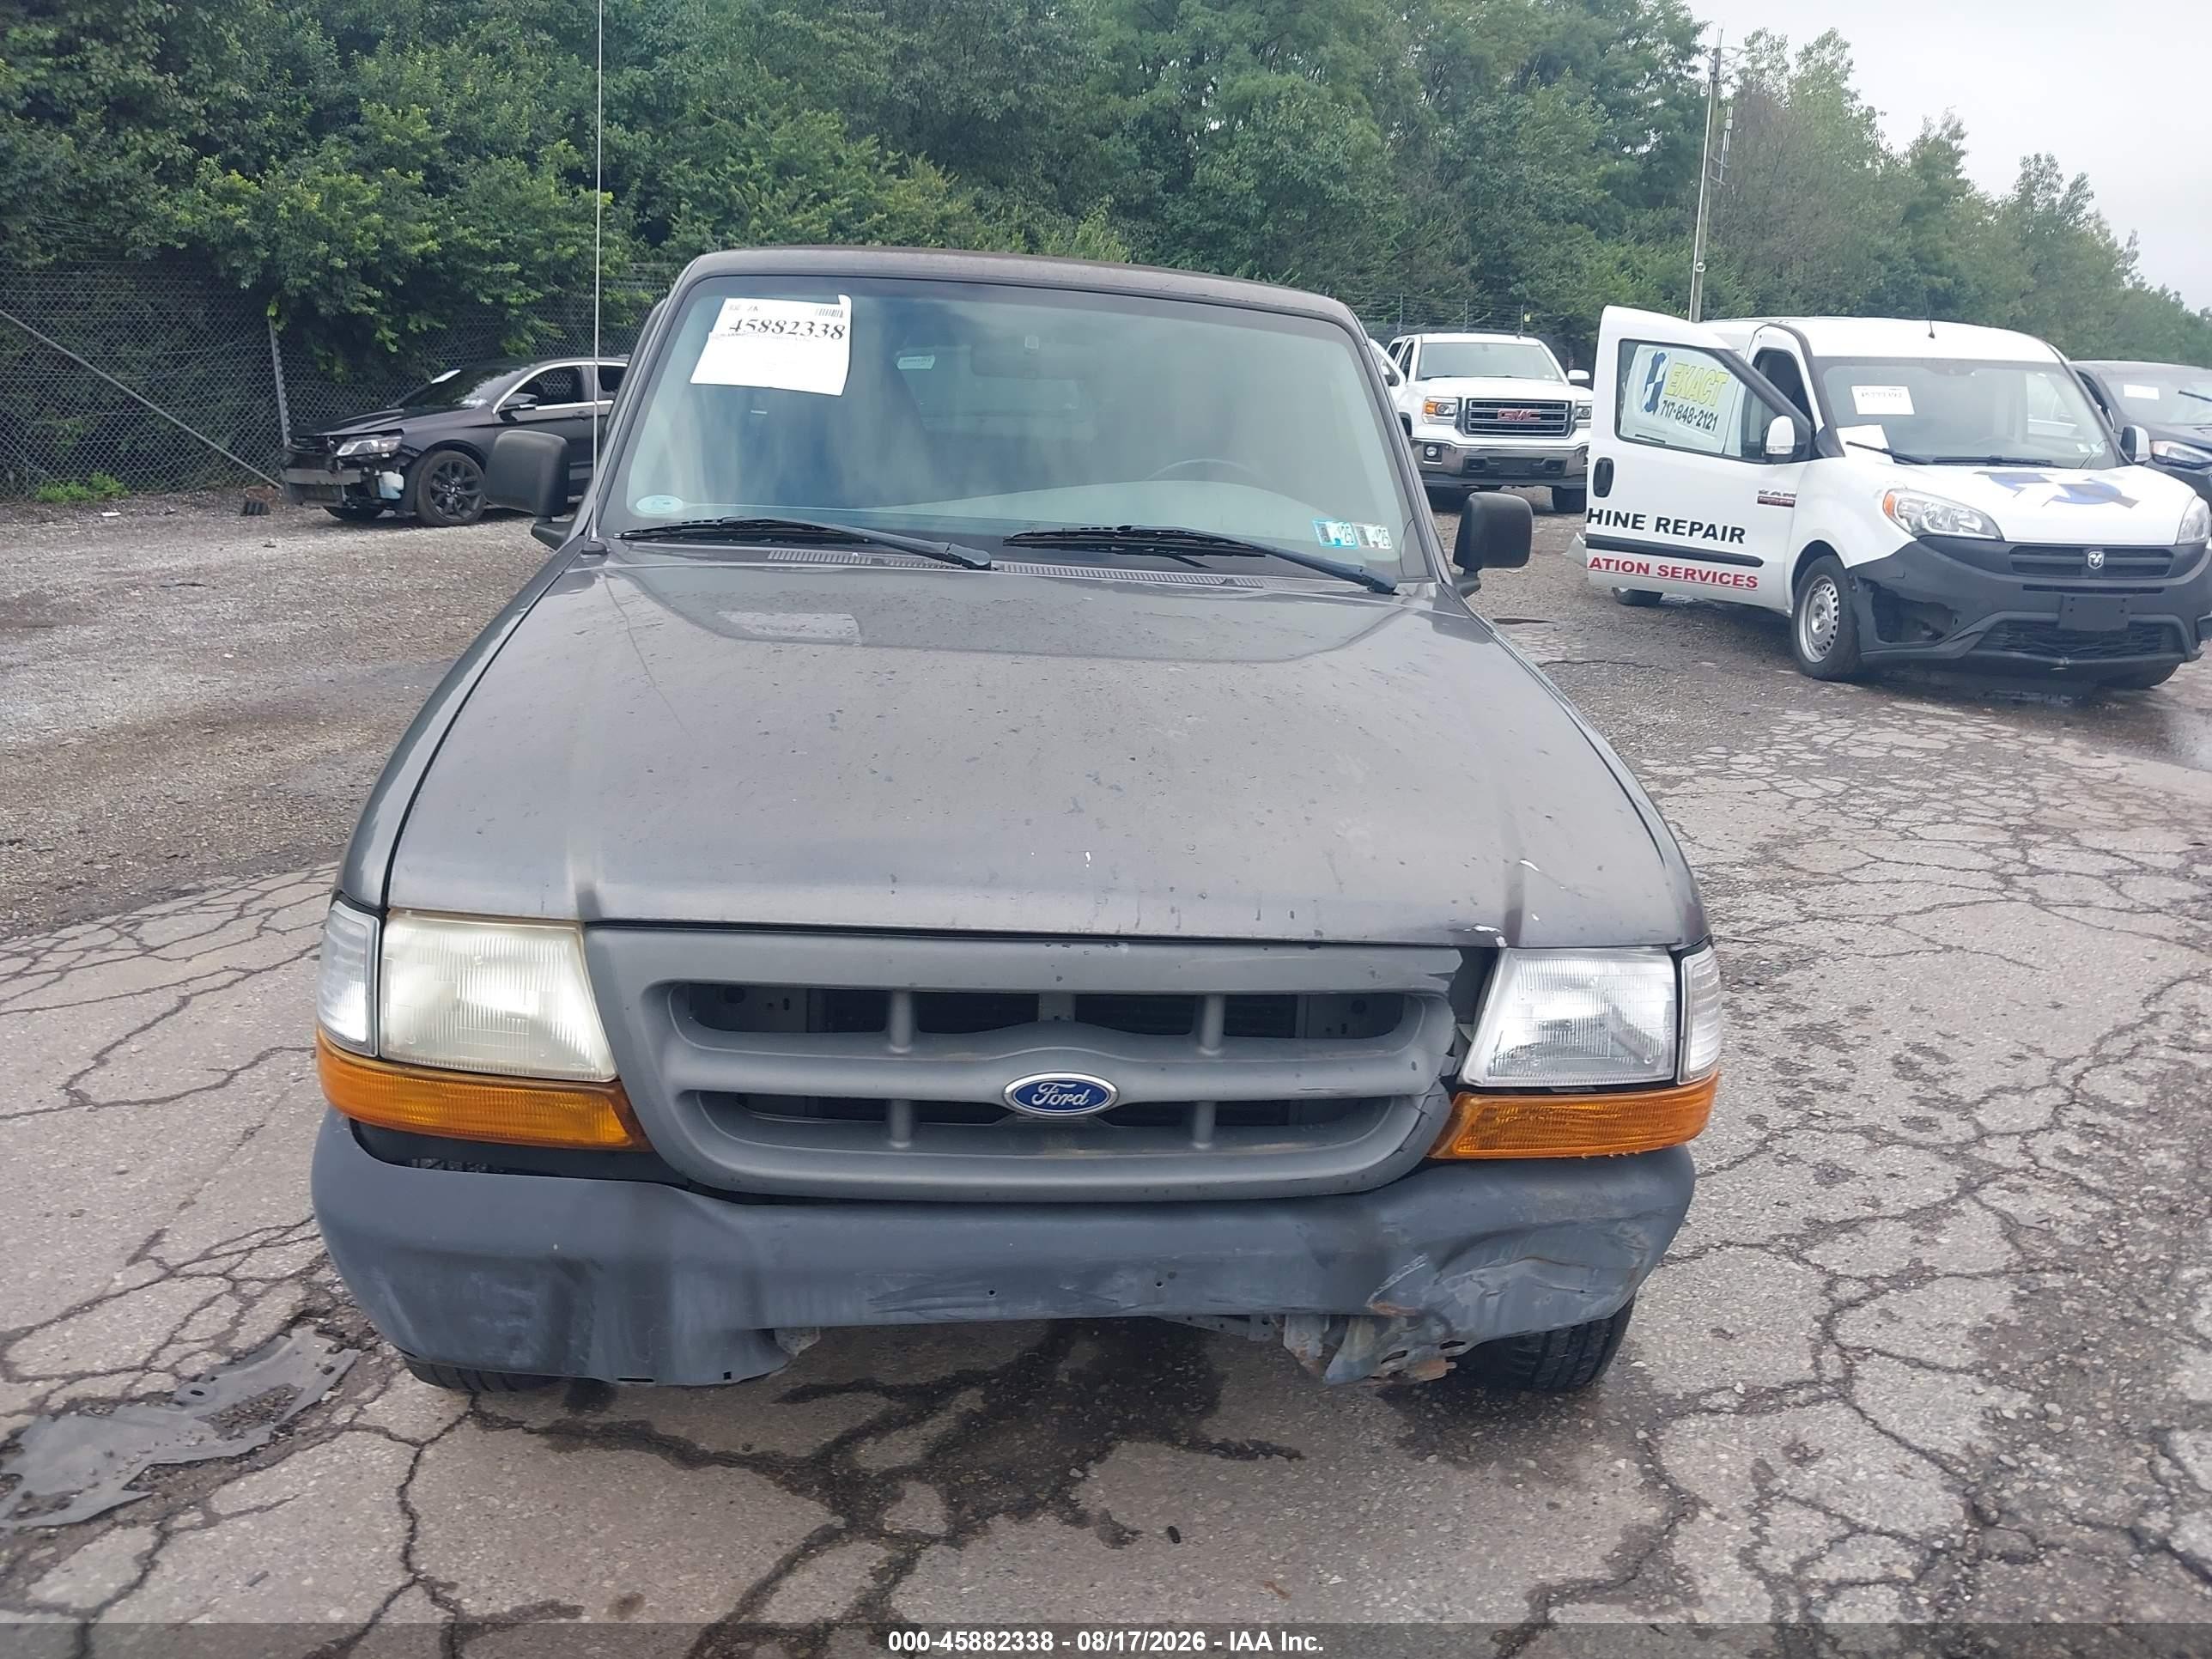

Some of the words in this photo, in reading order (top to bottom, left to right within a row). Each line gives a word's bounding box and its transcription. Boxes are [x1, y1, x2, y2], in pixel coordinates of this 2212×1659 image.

[728, 318, 846, 340] 45882338
[1664, 362, 1730, 407] EXACT
[1498, 408, 1540, 421] GMC
[1587, 507, 1647, 531] HINE
[1654, 516, 1746, 544] REPAIR
[1589, 557, 1650, 574] ATION
[1656, 565, 1759, 588] SERVICES
[1031, 1082, 1091, 1106] Ford
